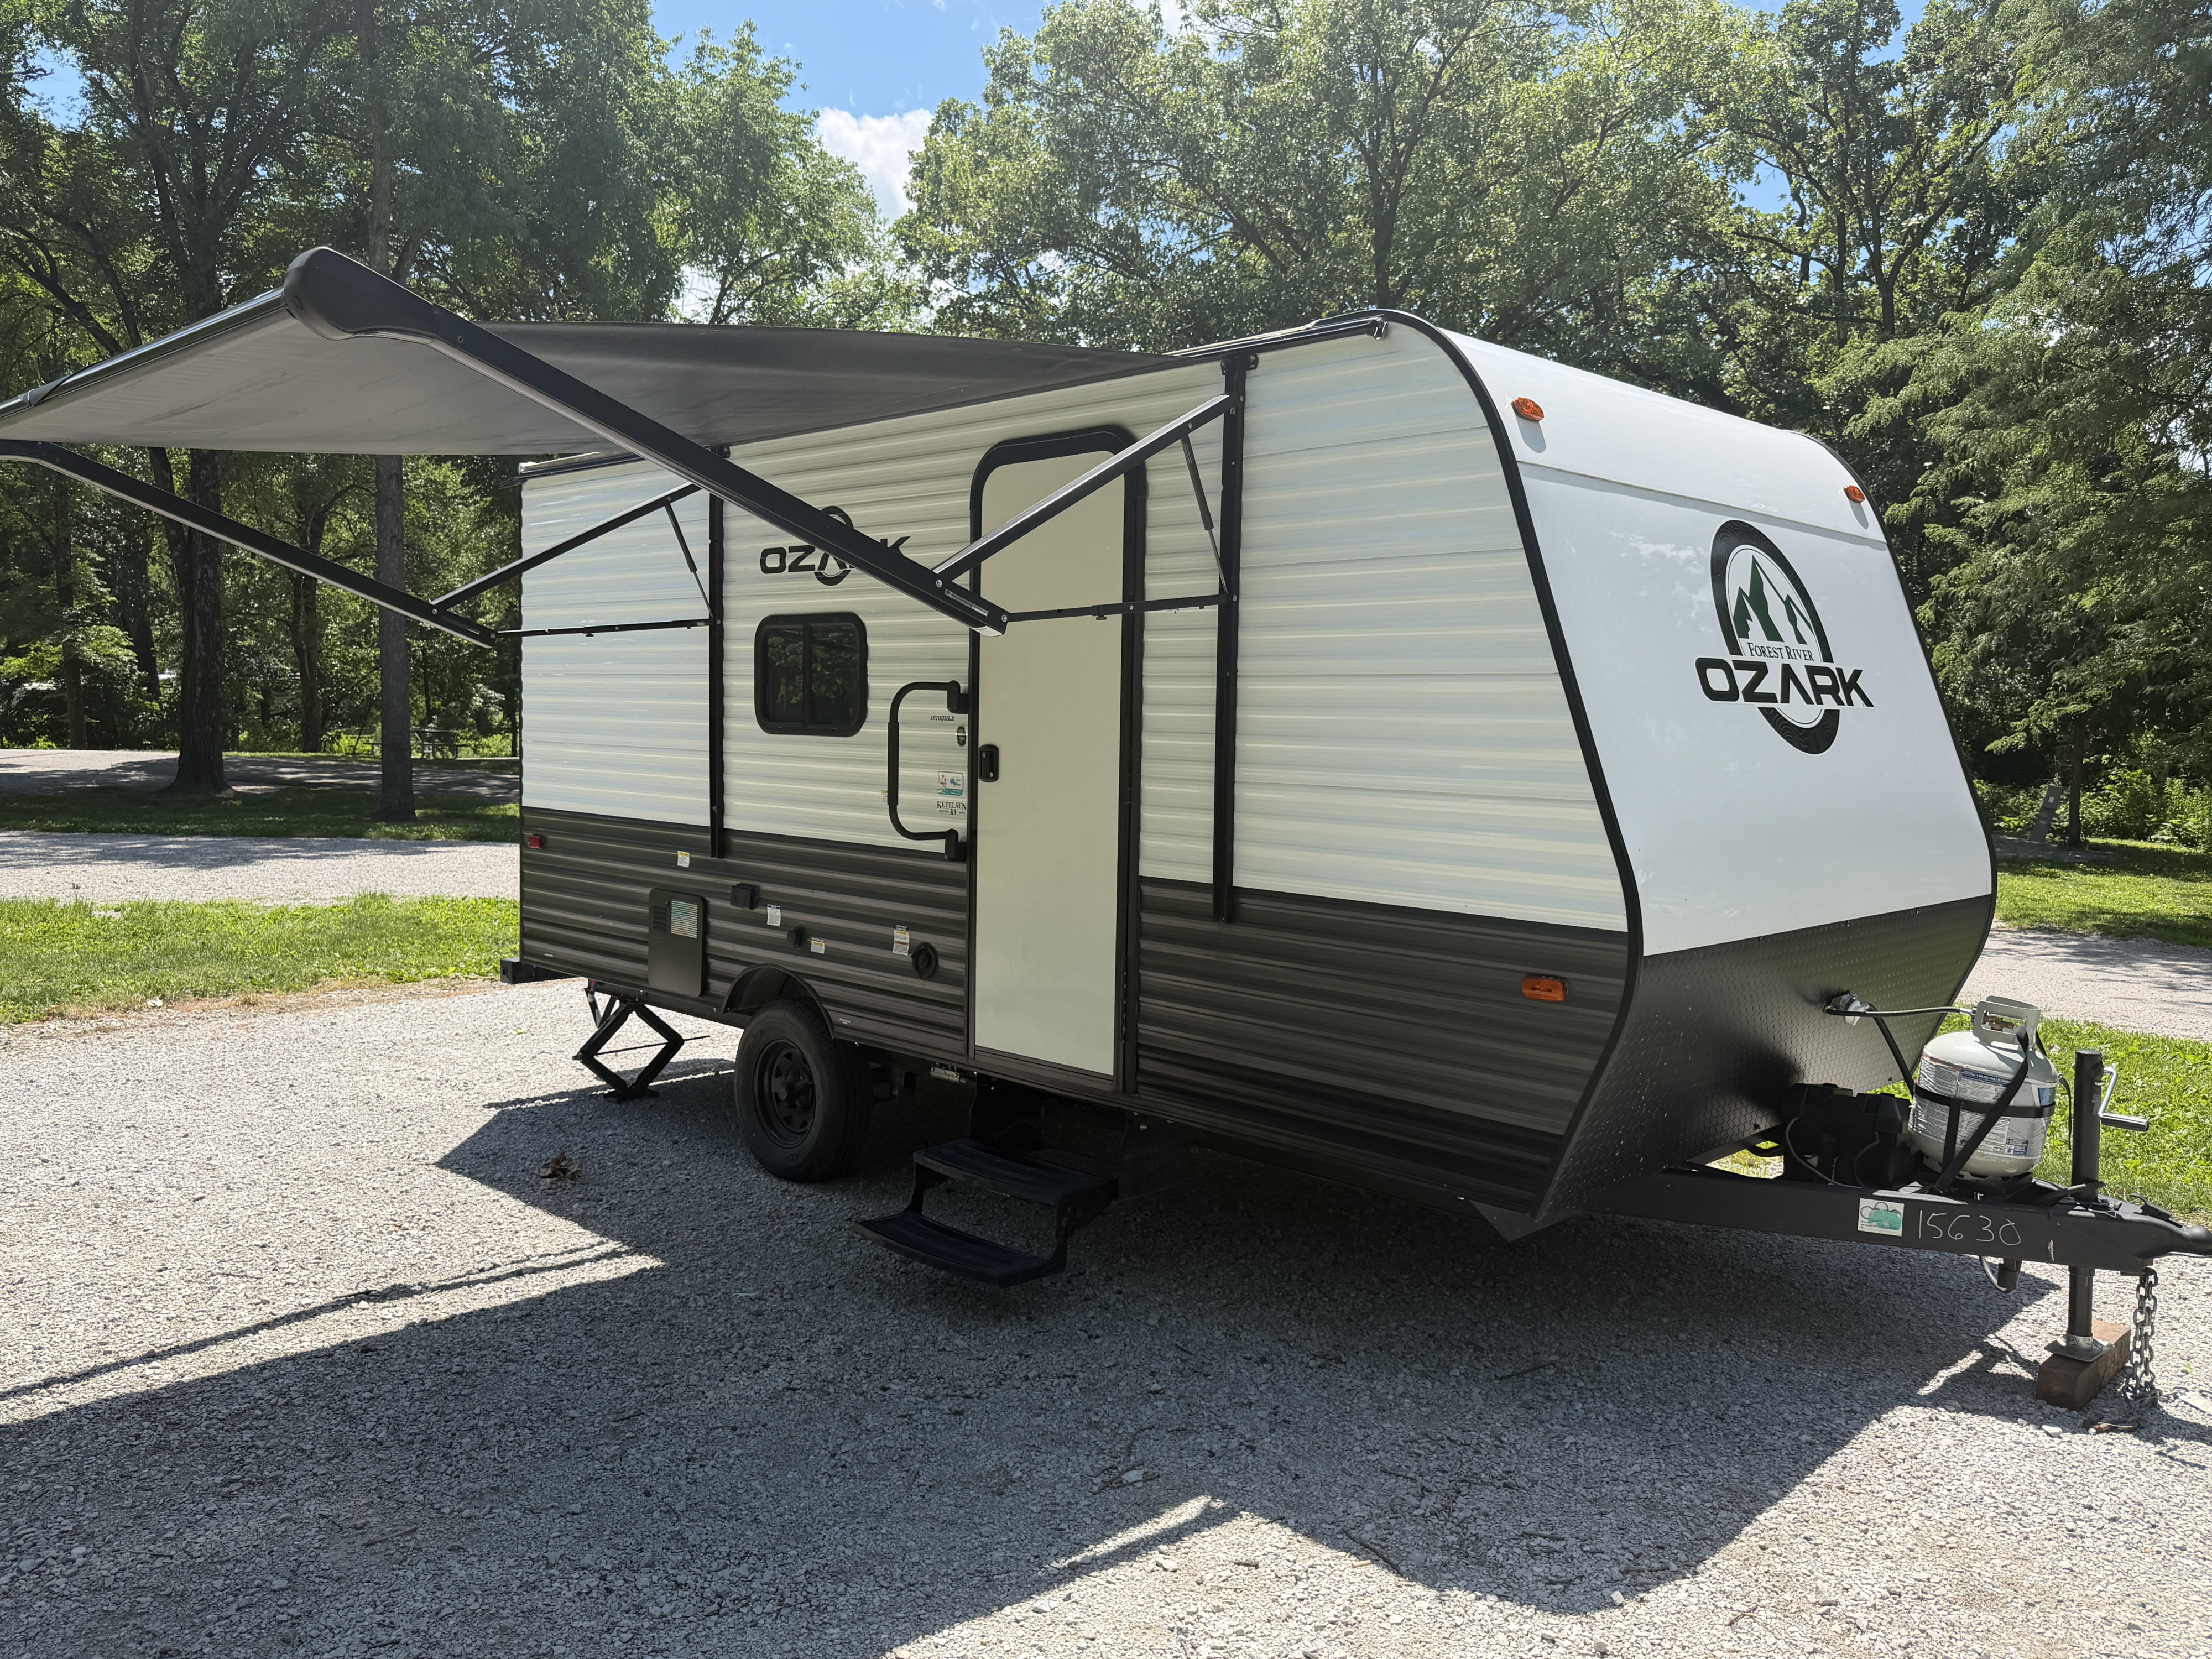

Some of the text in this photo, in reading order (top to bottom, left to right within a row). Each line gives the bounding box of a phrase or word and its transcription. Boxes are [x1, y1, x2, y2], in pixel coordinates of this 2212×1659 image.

[1748, 643, 1814, 661] FOREST RIVER
[1695, 658, 1874, 707] OZARK
[937, 801, 966, 810] KETELSEN
